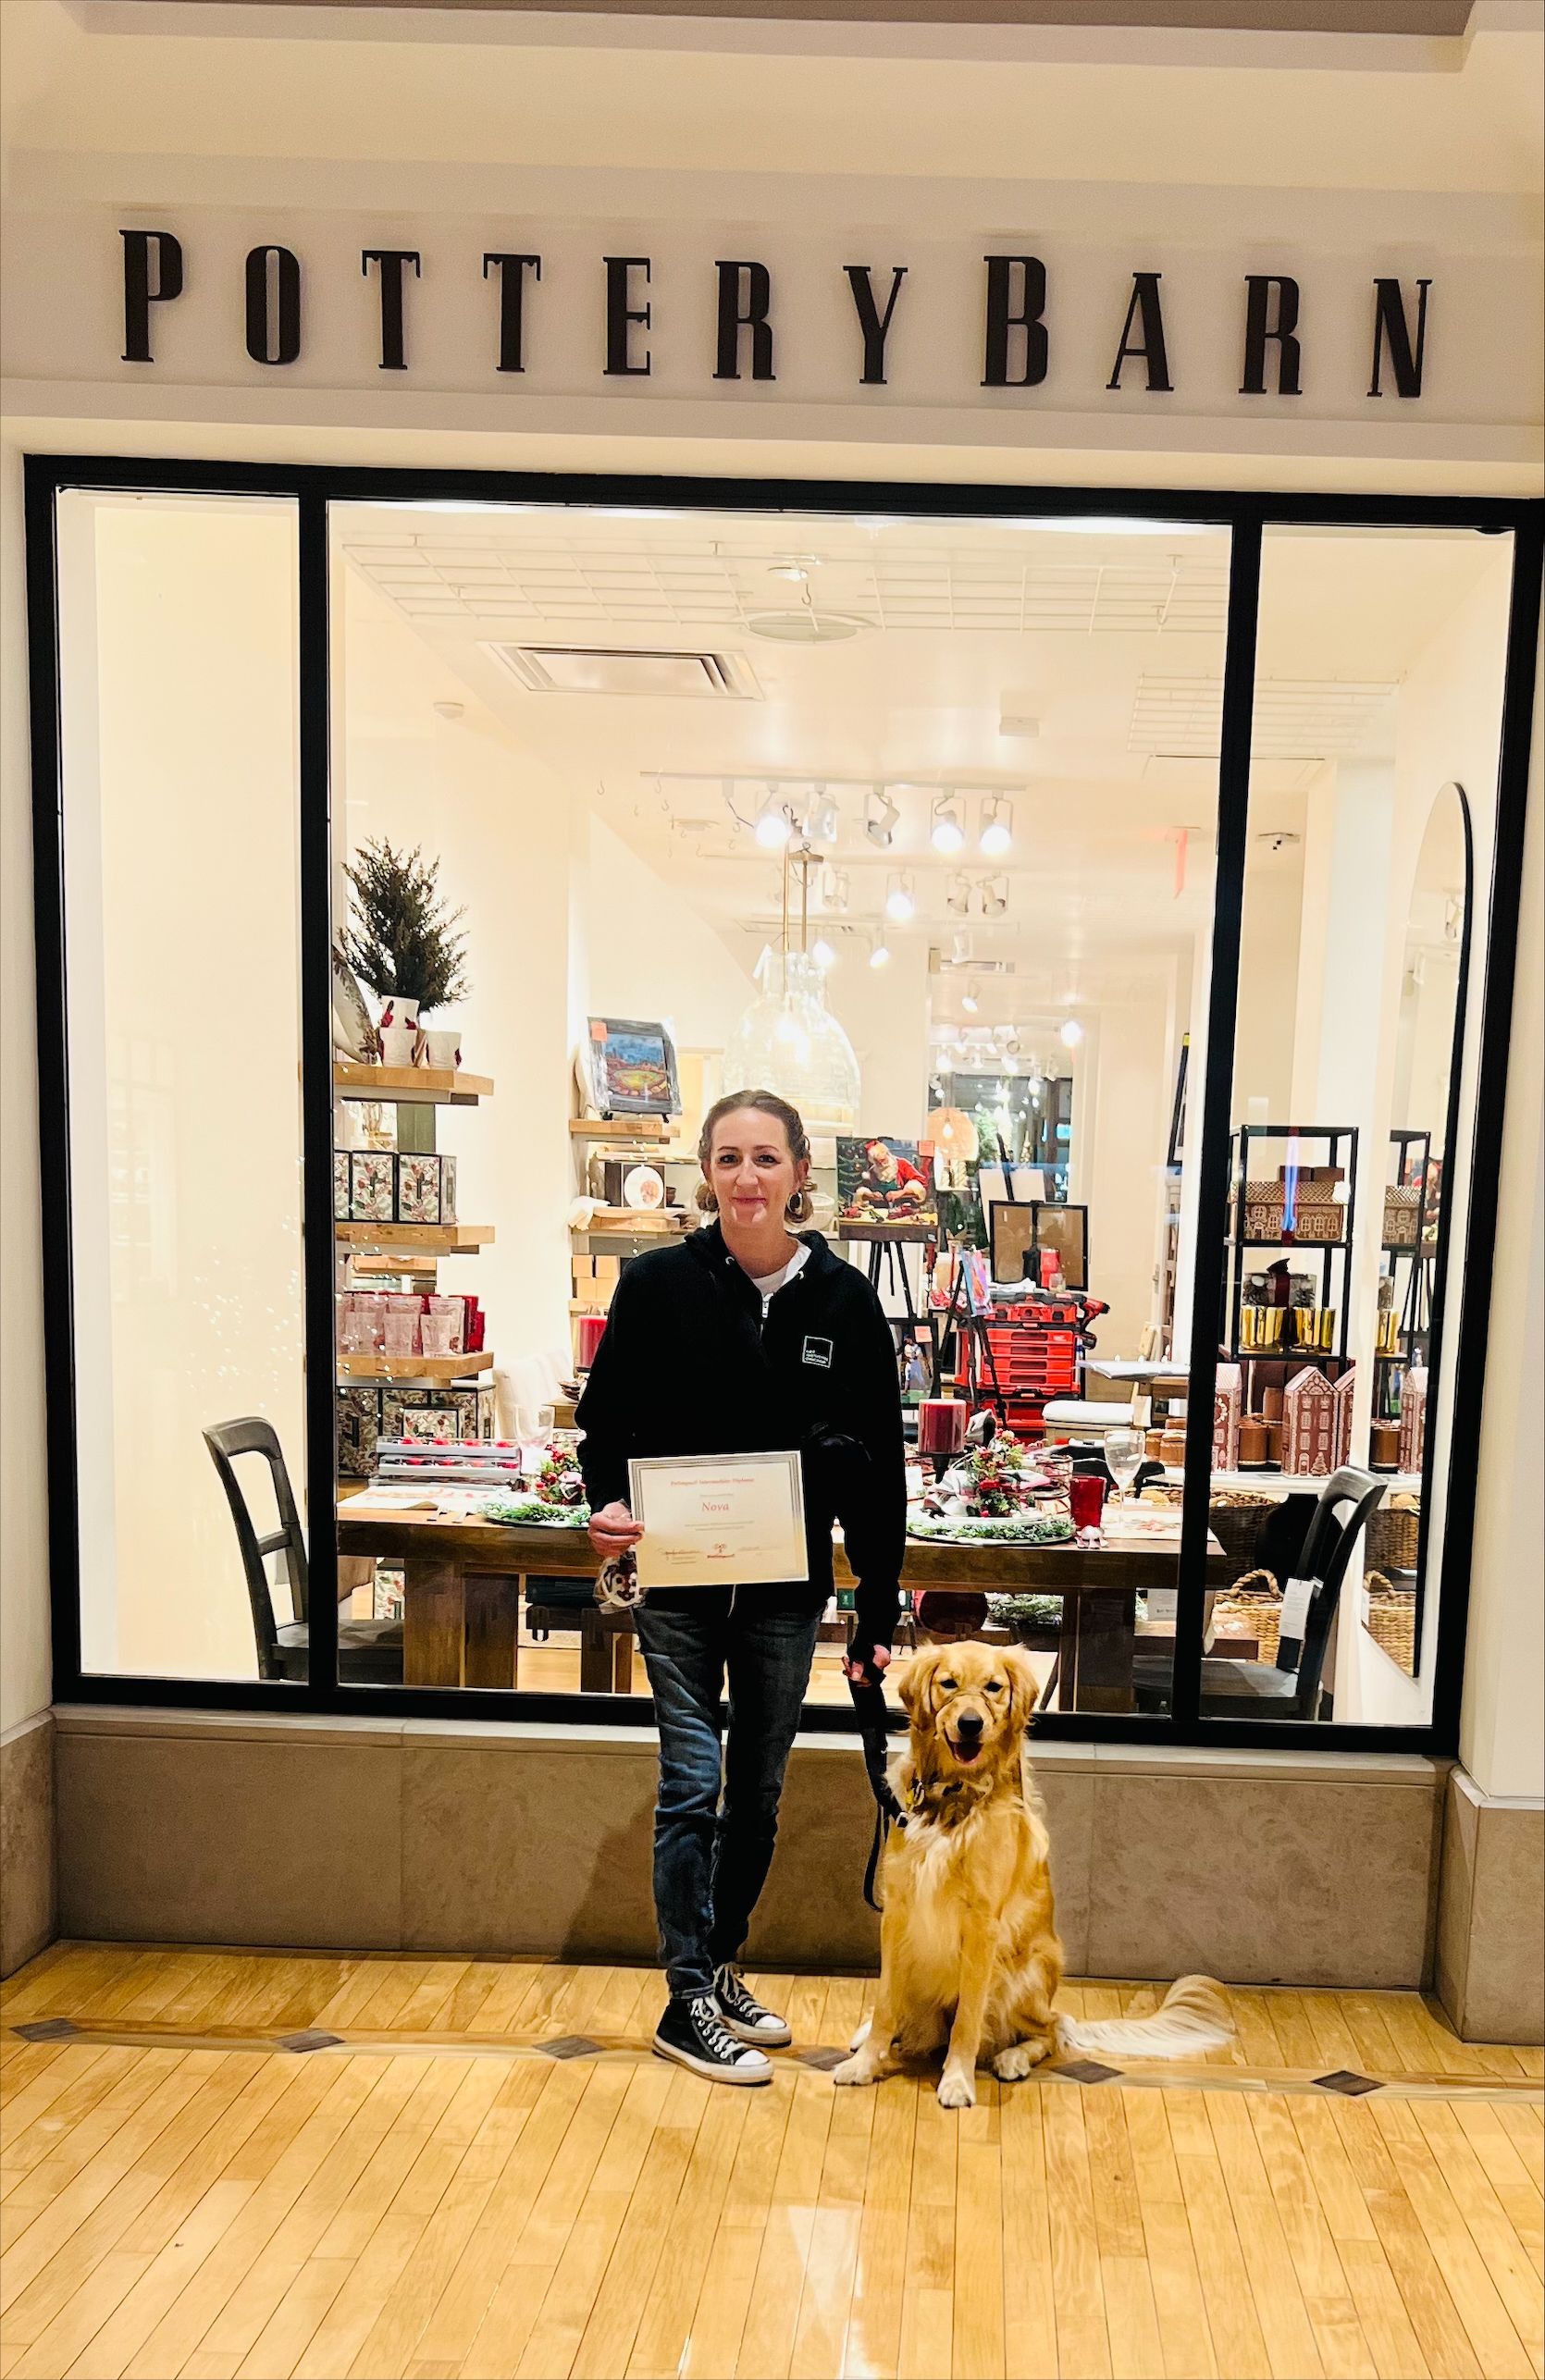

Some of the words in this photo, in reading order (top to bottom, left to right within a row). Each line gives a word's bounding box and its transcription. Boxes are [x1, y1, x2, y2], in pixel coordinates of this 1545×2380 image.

[118, 229, 908, 385] POTTERY
[980, 255, 1433, 399] BARN
[701, 1501, 729, 1511] Nova
